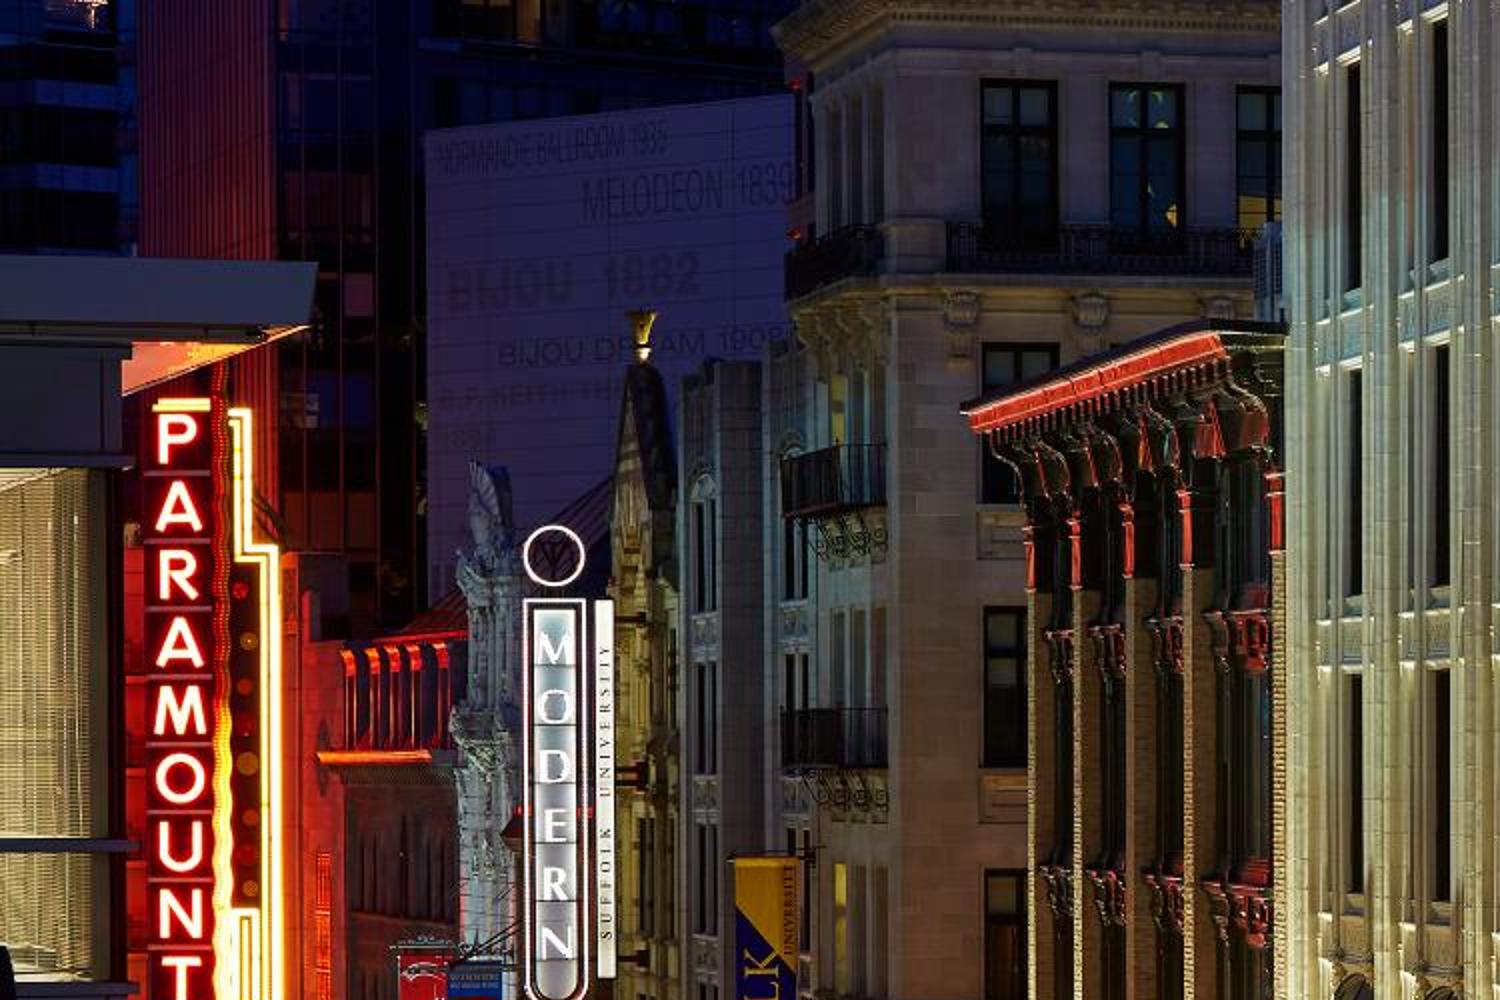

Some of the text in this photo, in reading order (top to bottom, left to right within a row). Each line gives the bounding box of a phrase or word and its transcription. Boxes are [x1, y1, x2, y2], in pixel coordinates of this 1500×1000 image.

[537, 122, 625, 167] BALLROOM
[582, 168, 723, 221] MELODEON
[447, 250, 702, 313] BIJOU 1882
[498, 336, 584, 368] BIJOU
[593, 331, 705, 363] DRAM
[537, 631, 573, 960] MODERN
[600, 647, 612, 941] SUFFOLK UNIVERSITY
